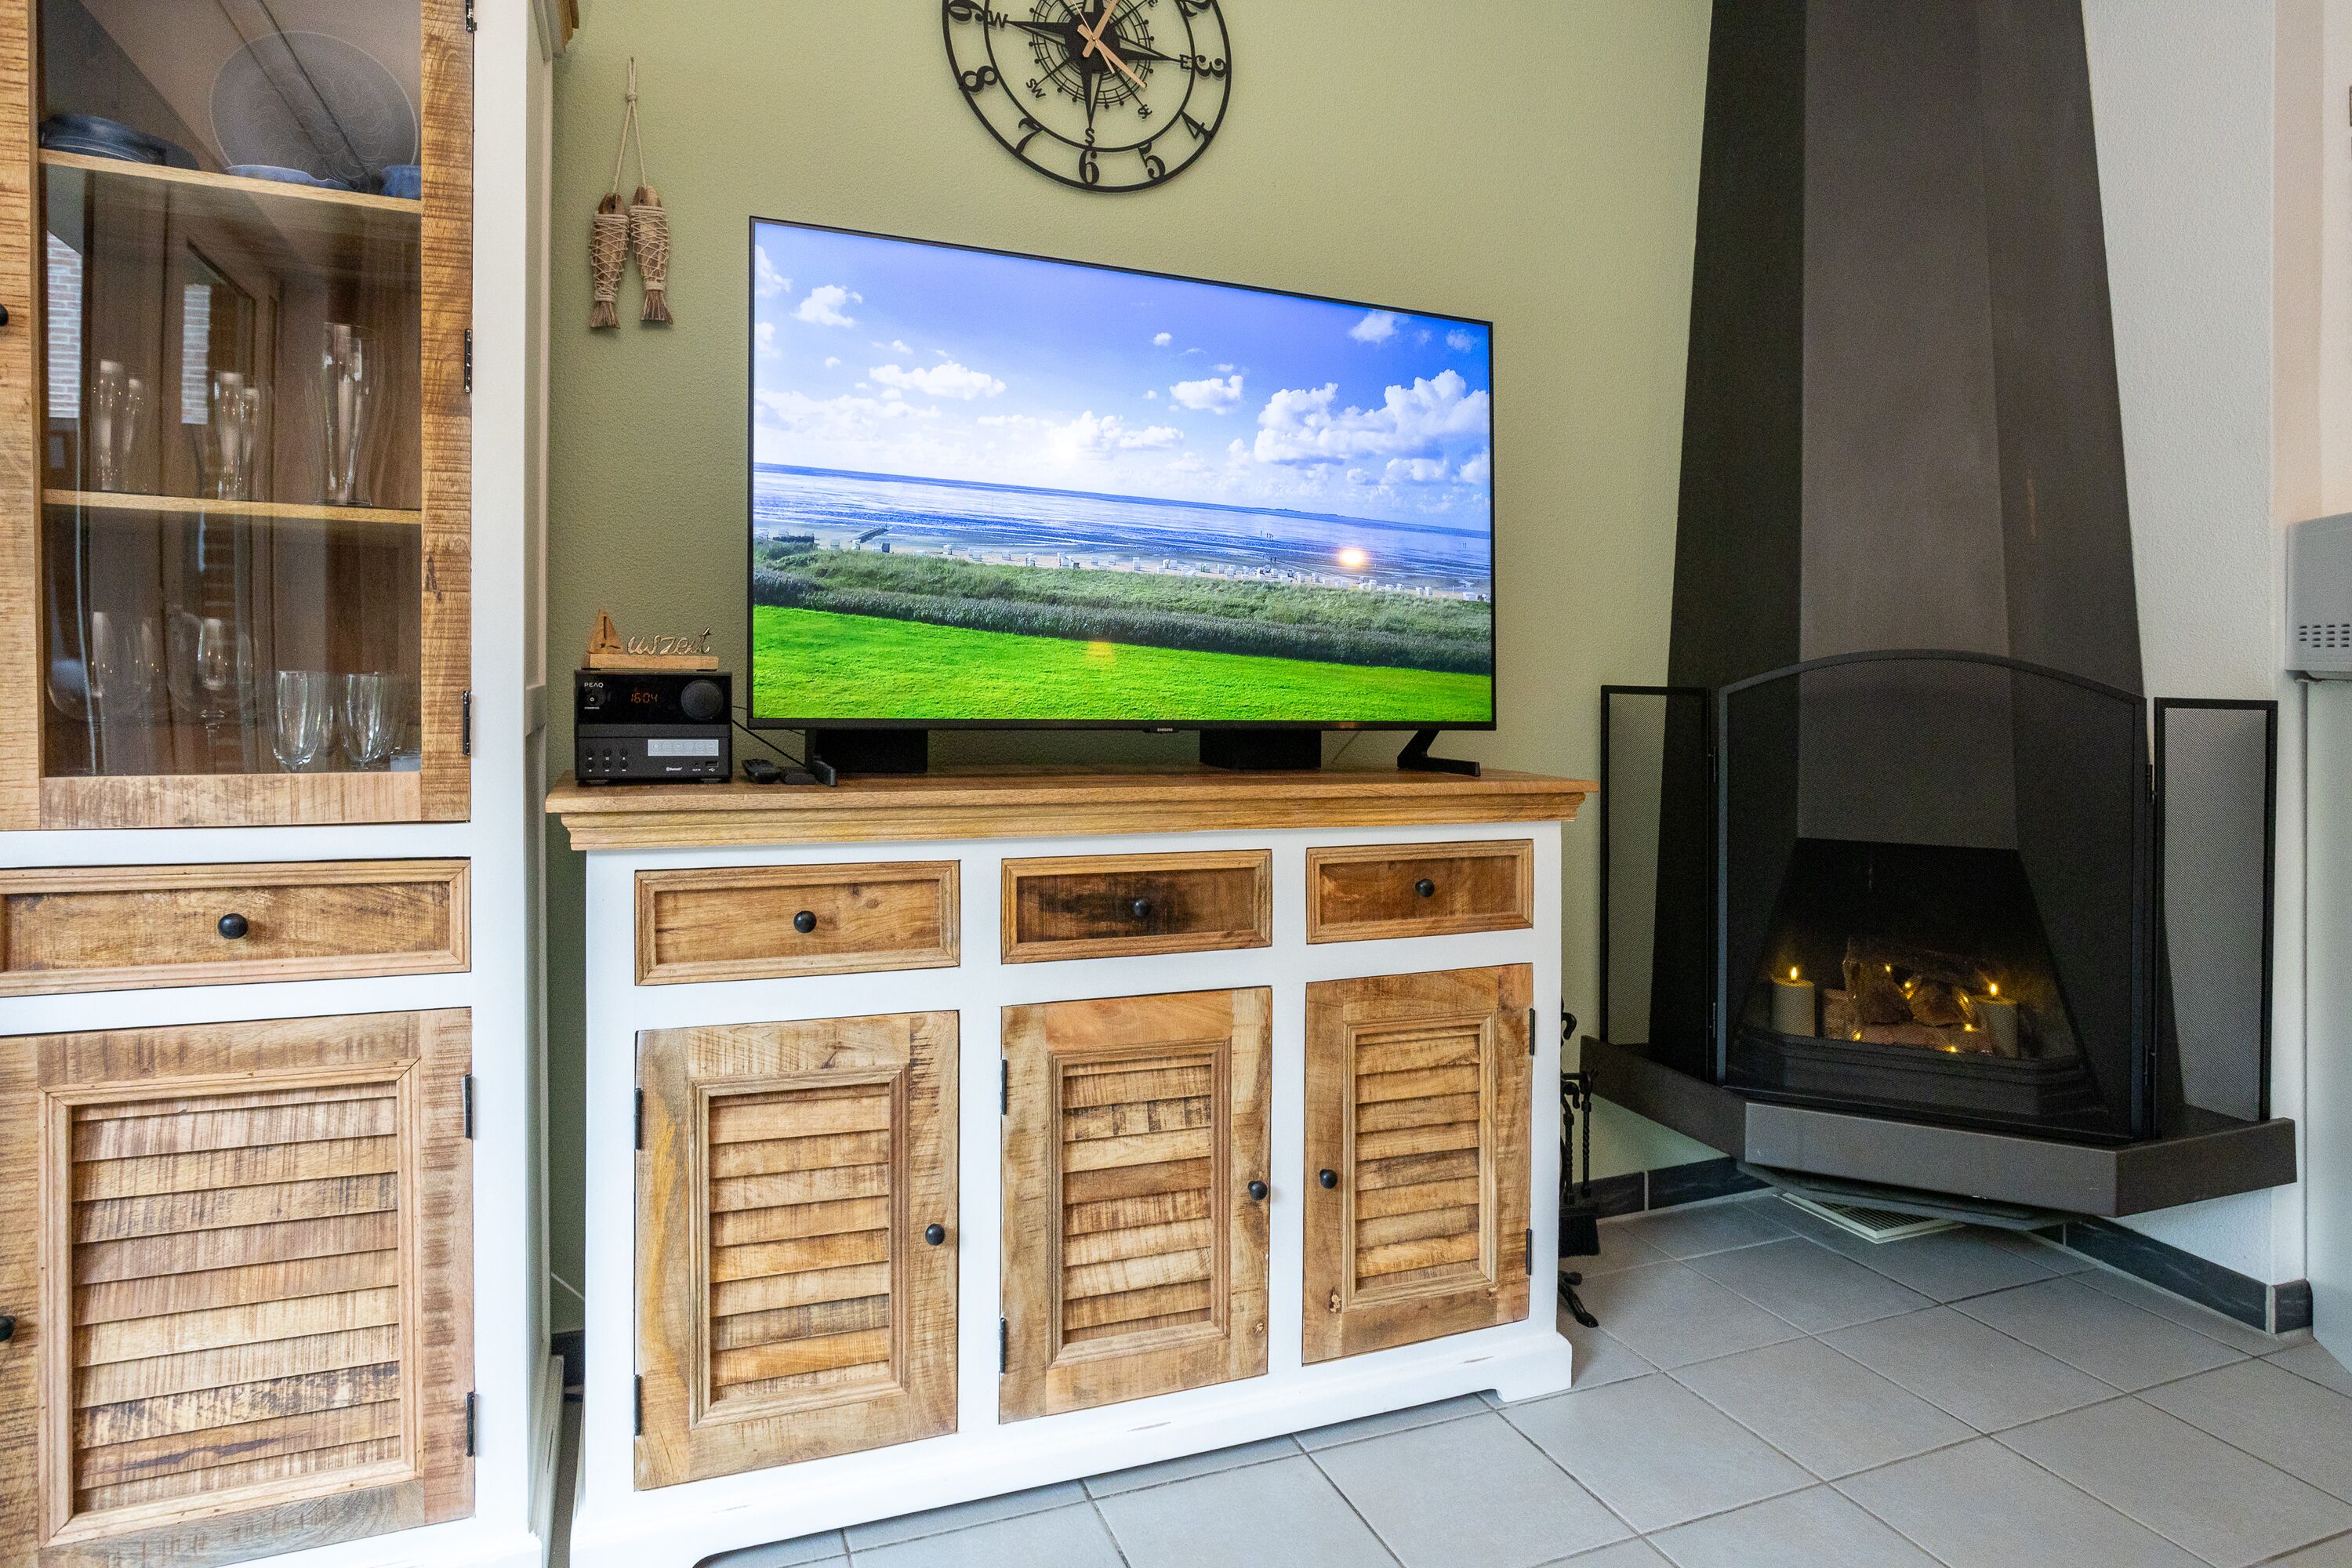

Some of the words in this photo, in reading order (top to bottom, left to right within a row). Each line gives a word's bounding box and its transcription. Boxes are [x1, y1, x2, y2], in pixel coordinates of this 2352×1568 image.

[987, 9, 1009, 28] W
[1179, 54, 1192, 70] E
[1195, 54, 1226, 78] 3
[962, 66, 998, 93] 8
[1018, 118, 1044, 157] 7
[1084, 128, 1095, 147] S
[1181, 111, 1212, 142] 4
[1078, 147, 1100, 185] 6
[1138, 141, 1166, 179] 5
[631, 692, 659, 703] 1604
